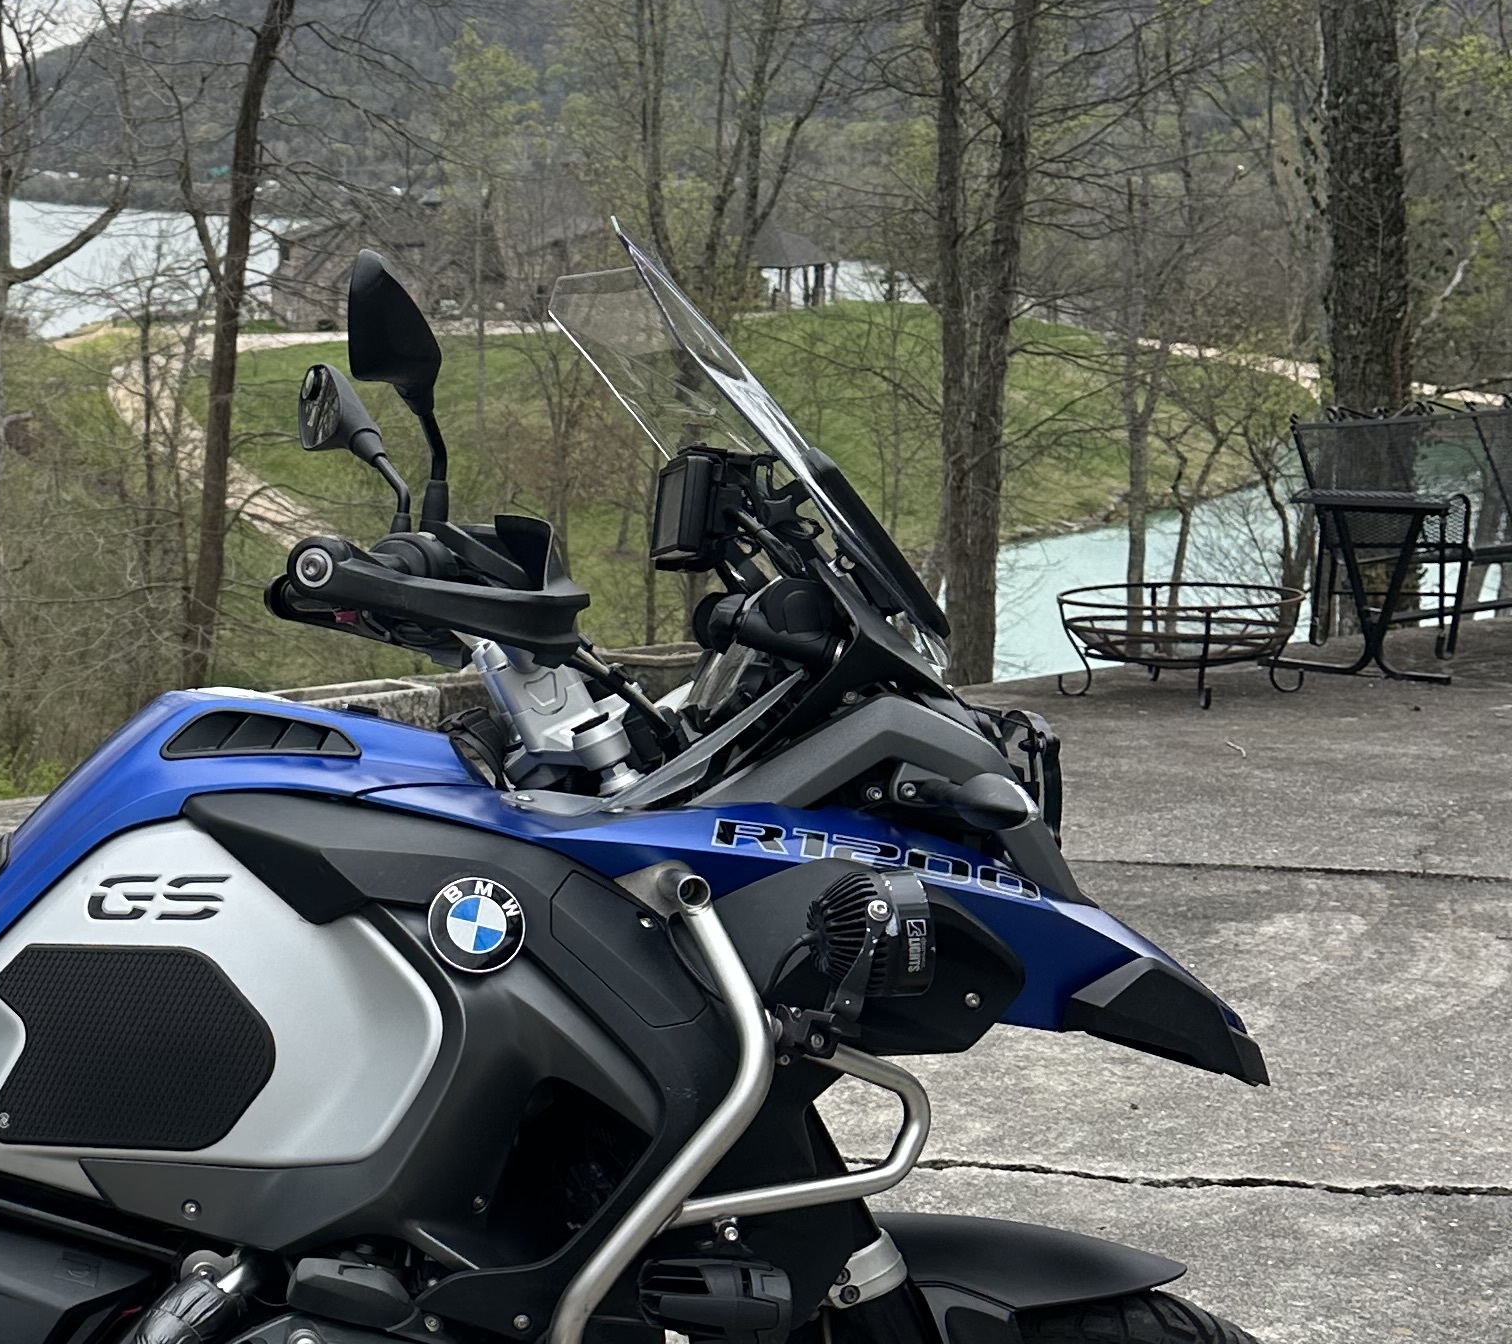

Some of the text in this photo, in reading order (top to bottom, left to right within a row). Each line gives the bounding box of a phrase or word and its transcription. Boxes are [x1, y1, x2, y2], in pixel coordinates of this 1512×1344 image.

[711, 817, 1041, 901] R1200
[87, 873, 232, 921] GS
[443, 880, 520, 917] BMW
[907, 937, 921, 973] LIGHTS
